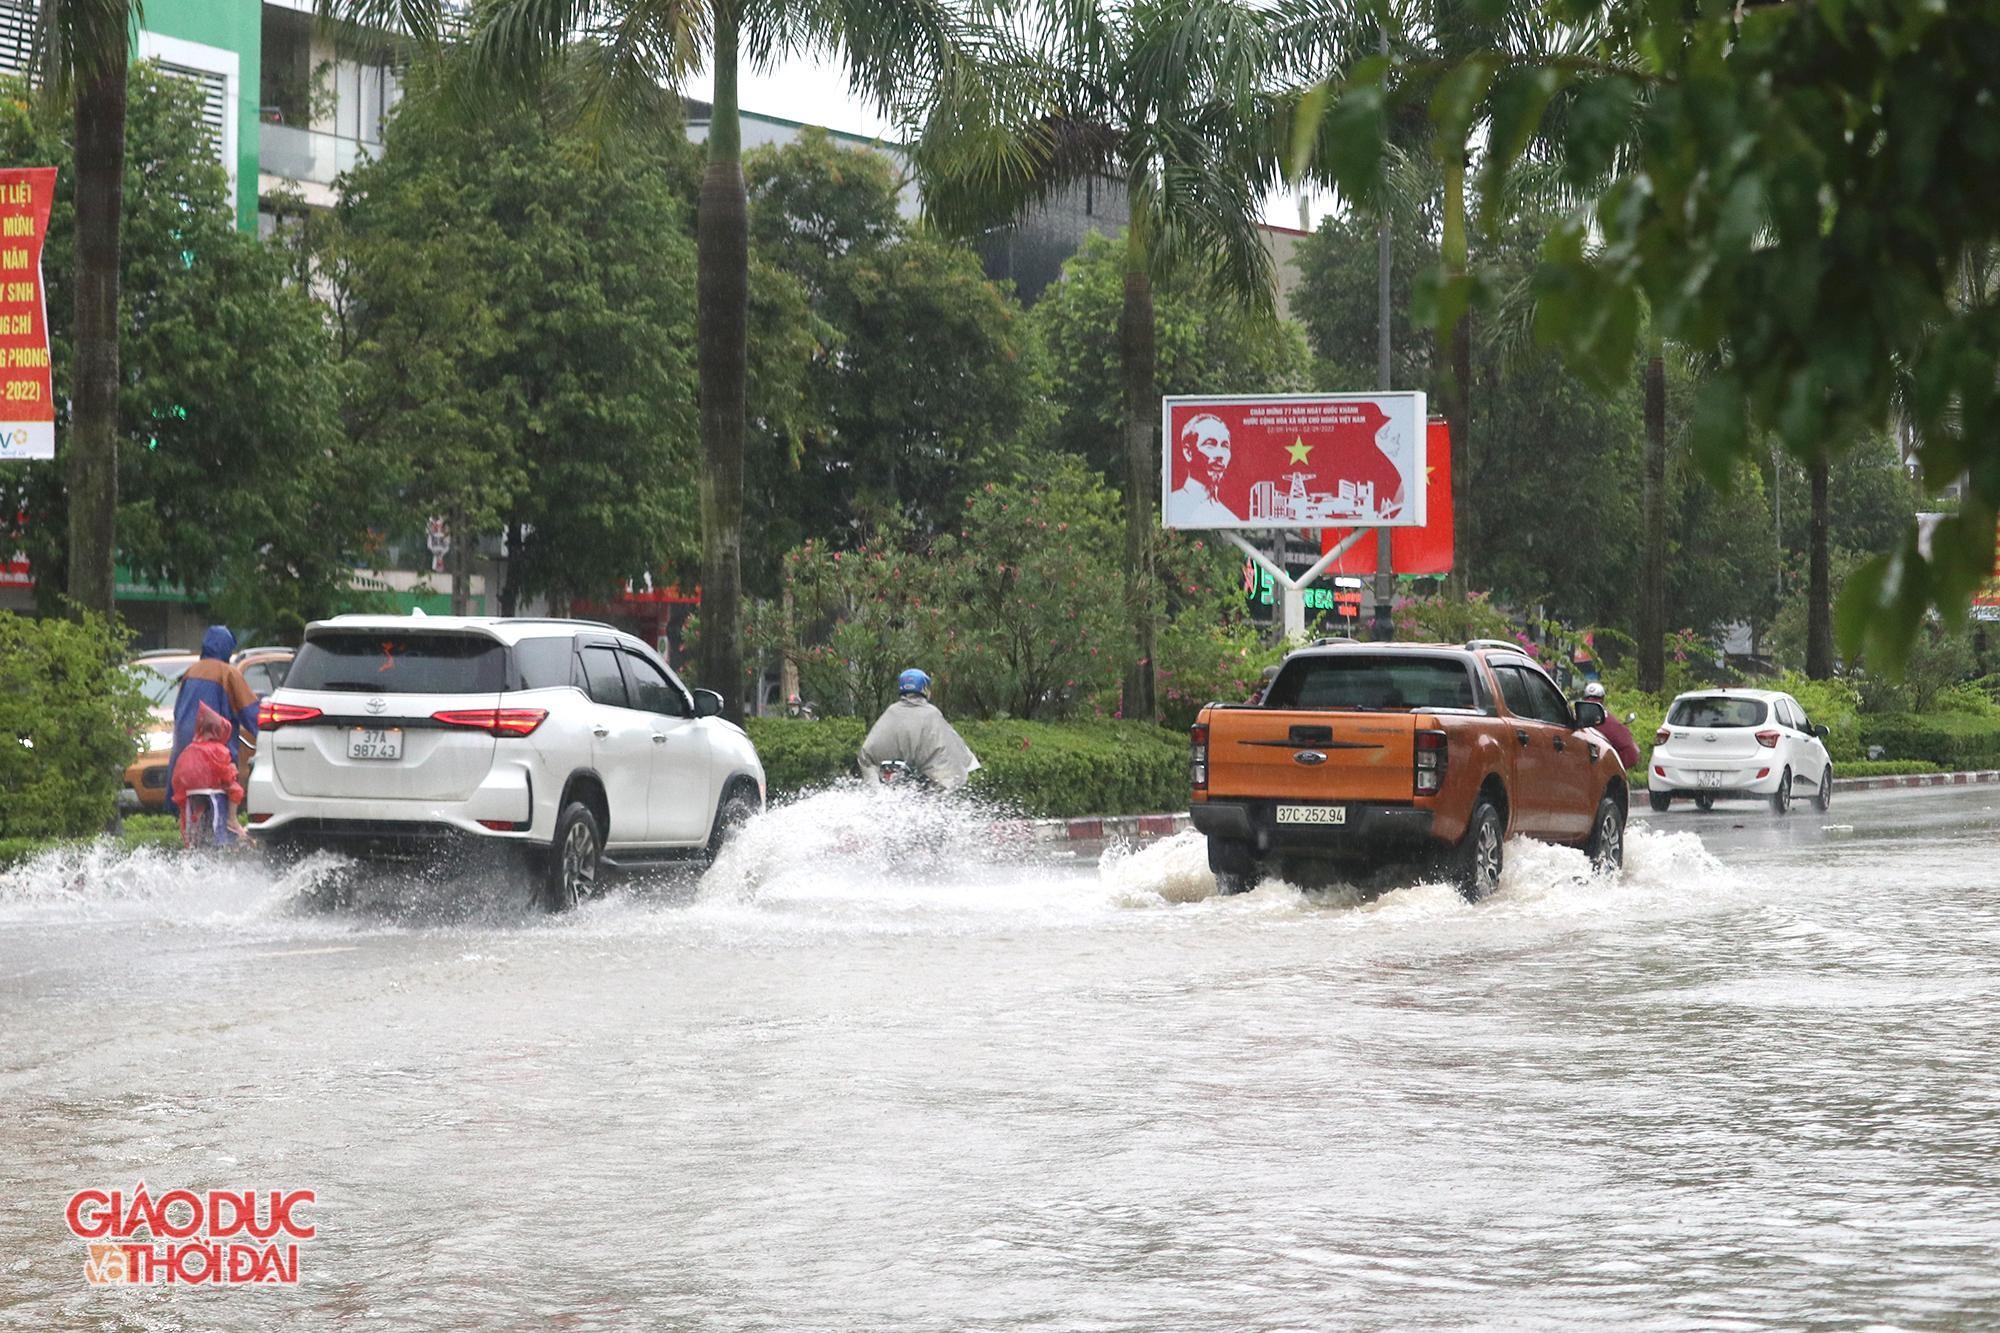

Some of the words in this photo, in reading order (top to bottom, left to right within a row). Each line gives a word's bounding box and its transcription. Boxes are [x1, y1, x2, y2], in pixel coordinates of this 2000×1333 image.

[2, 246, 28, 269] NĂM
[11, 312, 32, 334] CHÍ
[8, 347, 48, 367] PHONG
[6, 380, 40, 402] 2022)
[363, 730, 386, 743] 37A
[353, 744, 396, 758] 987.43
